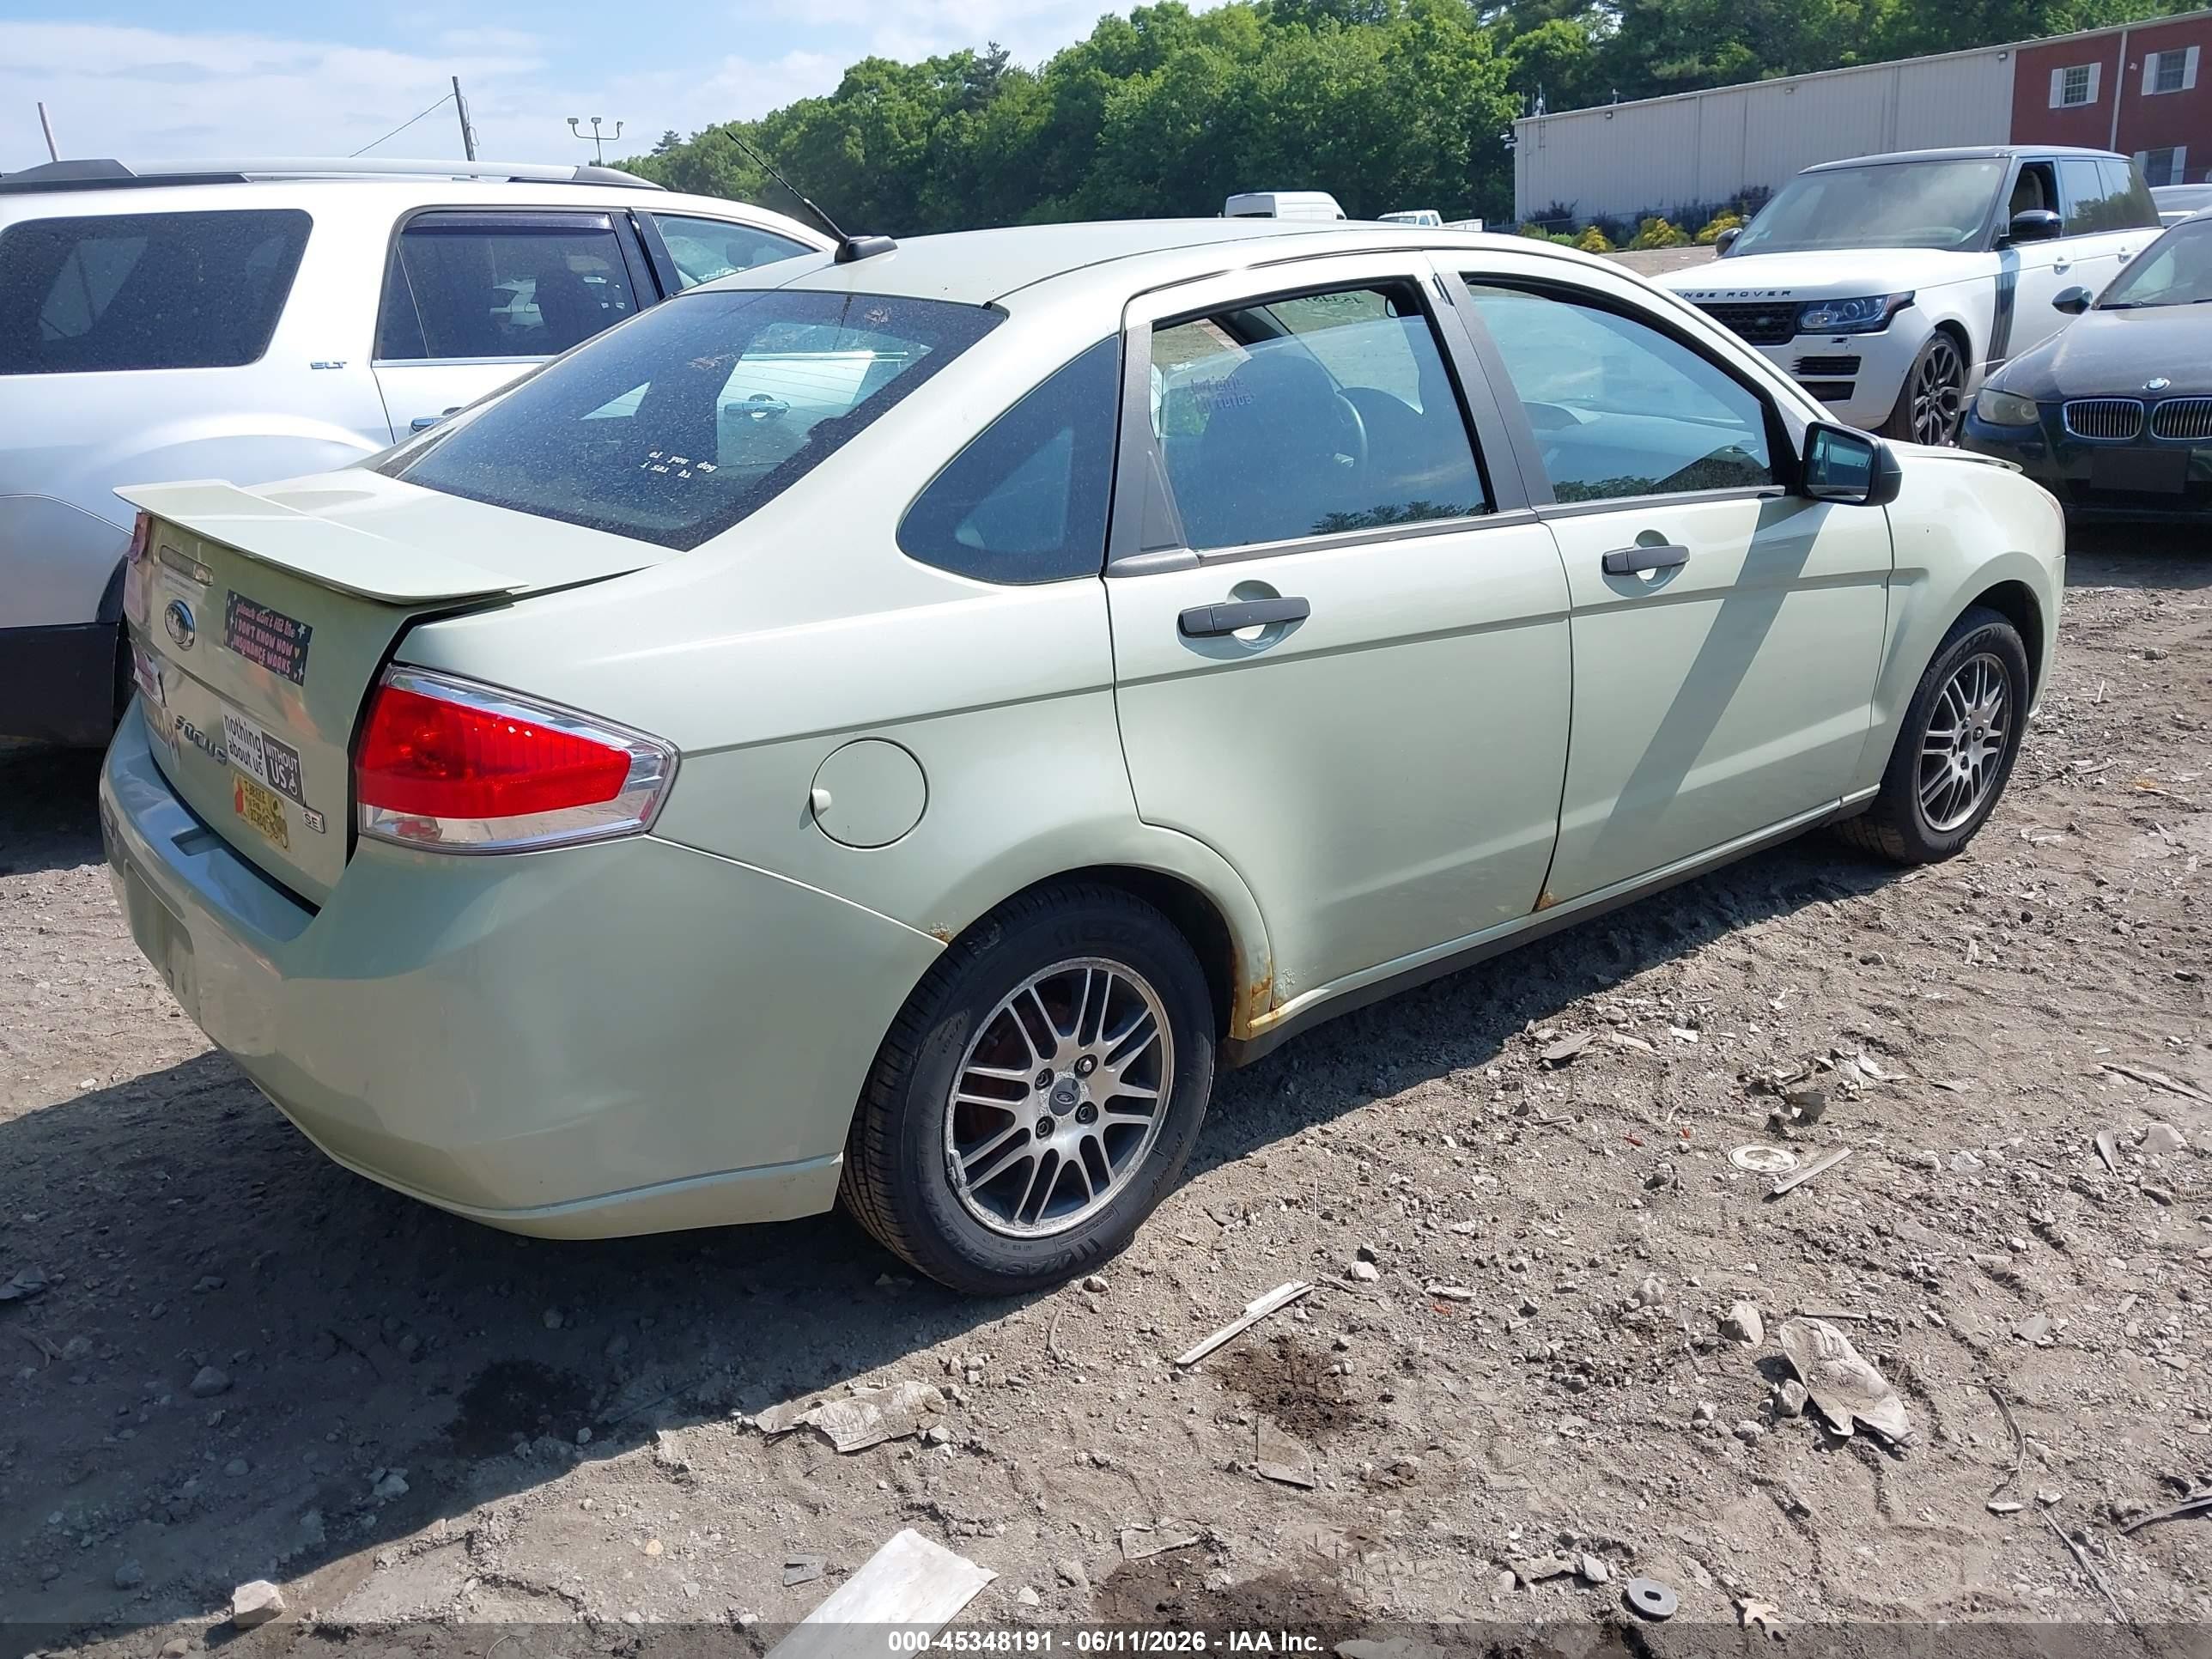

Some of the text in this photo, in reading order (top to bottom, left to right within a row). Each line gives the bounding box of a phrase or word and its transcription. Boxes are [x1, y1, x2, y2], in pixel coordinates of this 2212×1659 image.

[696, 461, 719, 474] dog
[233, 634, 291, 674] INSURANCE WORKS
[256, 627, 276, 649] KNOW
[276, 637, 293, 657] HOW
[174, 714, 228, 766] FOCUS
[223, 714, 263, 761] nothing
[228, 736, 264, 776] about us
[264, 739, 299, 774] WITHOUT
[270, 758, 288, 789] US
[304, 813, 319, 830] SE
